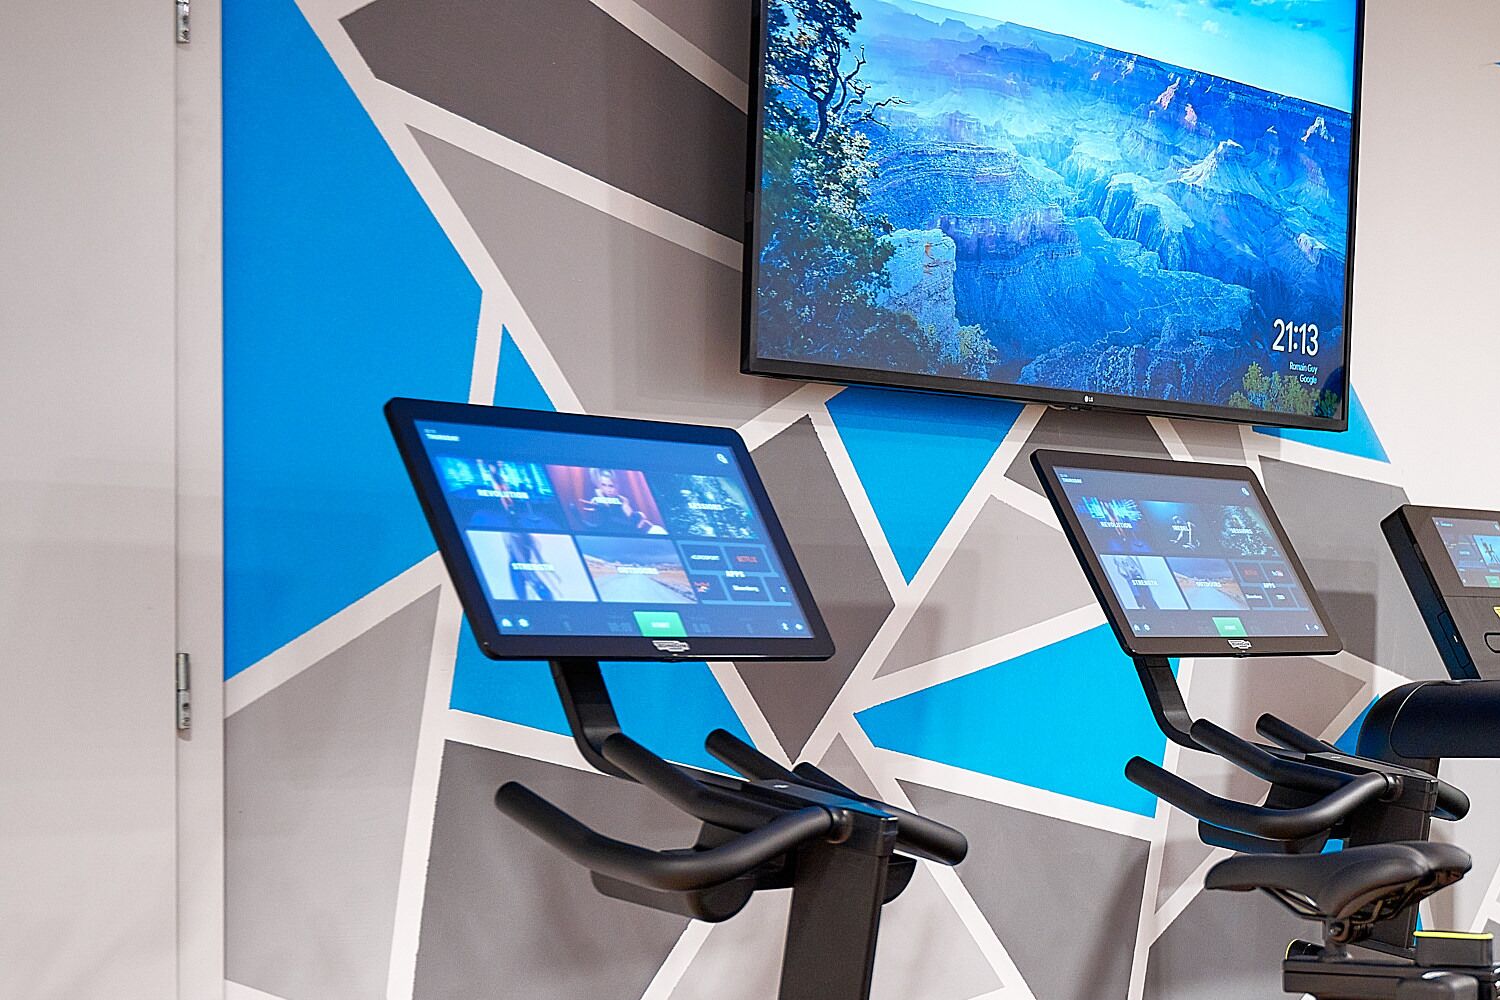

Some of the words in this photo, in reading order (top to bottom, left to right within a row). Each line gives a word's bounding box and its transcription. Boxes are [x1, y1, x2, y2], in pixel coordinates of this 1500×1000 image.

[1272, 318, 1319, 357] 21:13
[1307, 364, 1318, 375] Guy
[1299, 374, 1318, 386] Google
[476, 489, 529, 499] REVOLUTION
[1099, 521, 1133, 529] REVOLUTION
